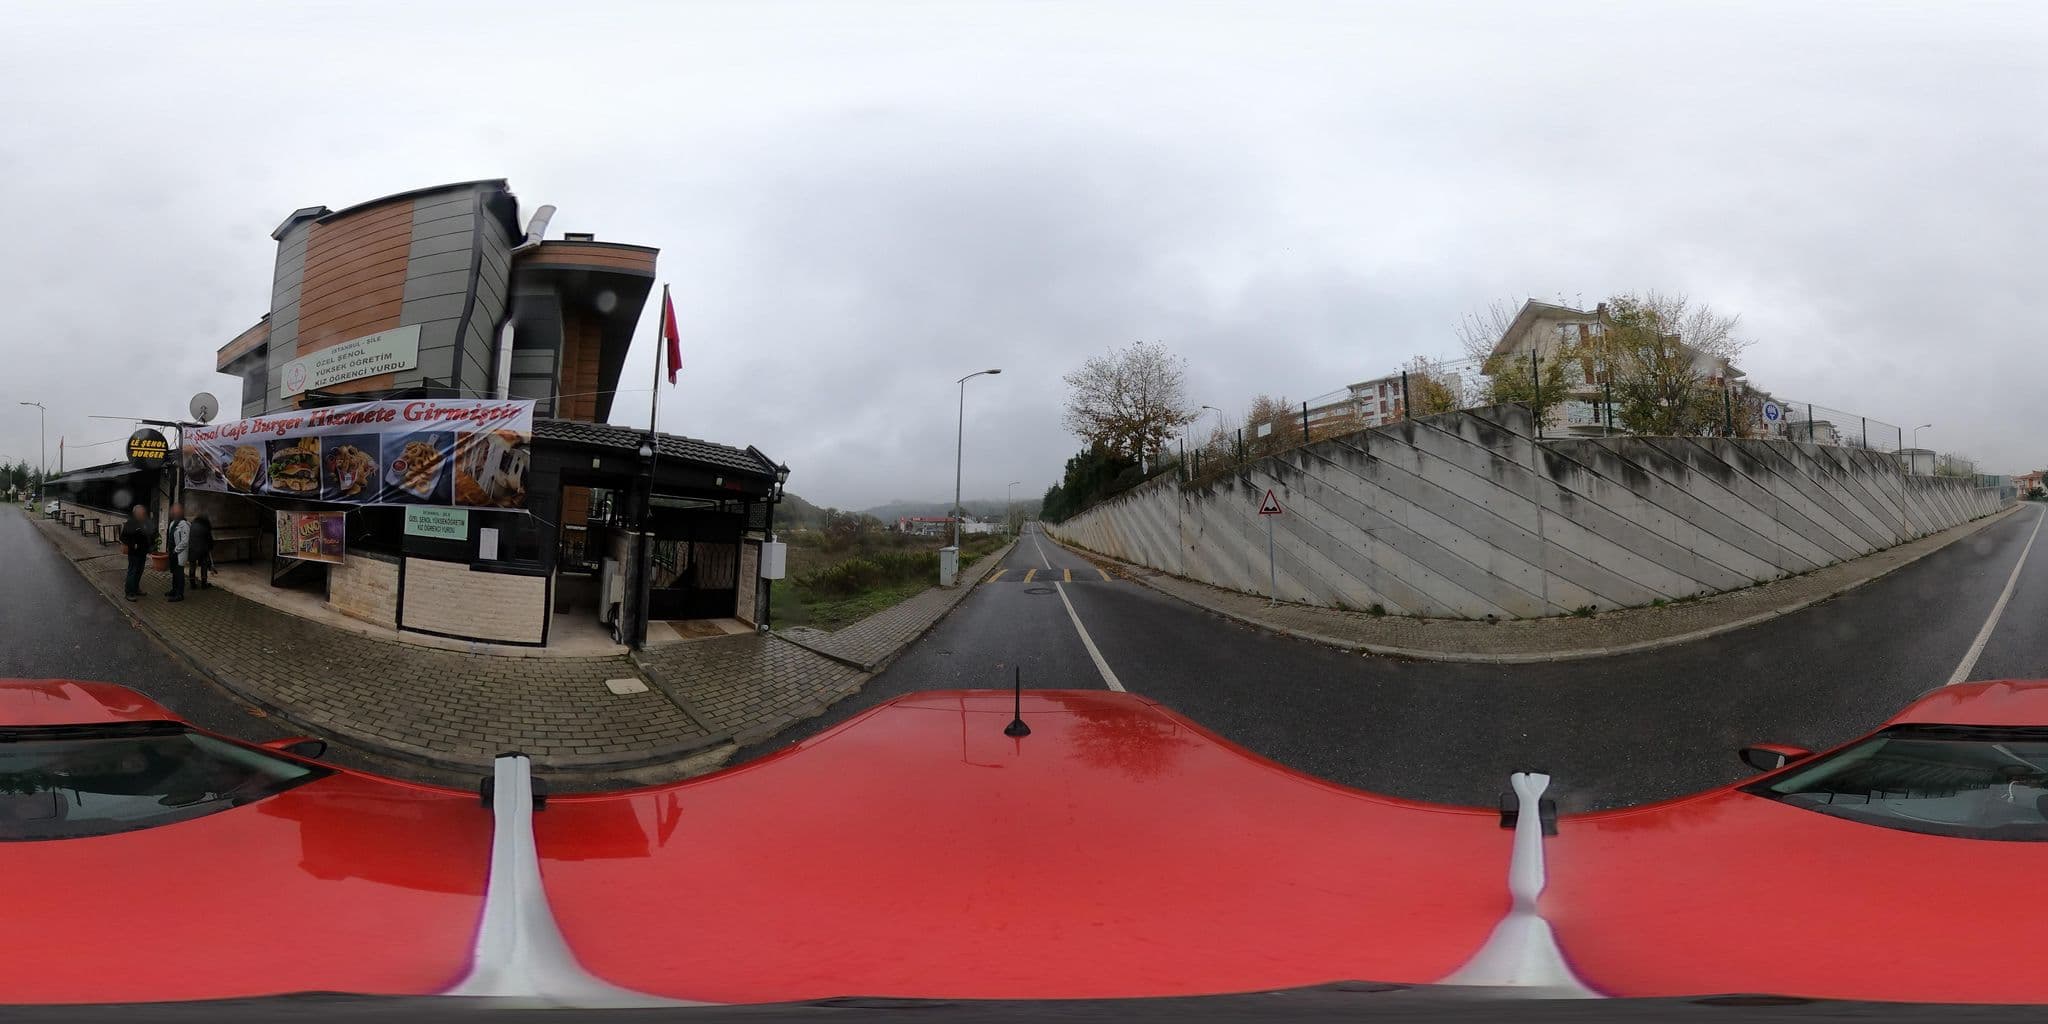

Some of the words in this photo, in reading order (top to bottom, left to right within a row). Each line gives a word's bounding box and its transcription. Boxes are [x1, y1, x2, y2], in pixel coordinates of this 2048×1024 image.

[370, 361, 406, 374] YURDU
[250, 417, 304, 436] Burger
[307, 406, 397, 428] Hizmete
[403, 401, 522, 427] Girmiştir
[131, 450, 165, 459] BURGER
[300, 520, 320, 537] UNO
